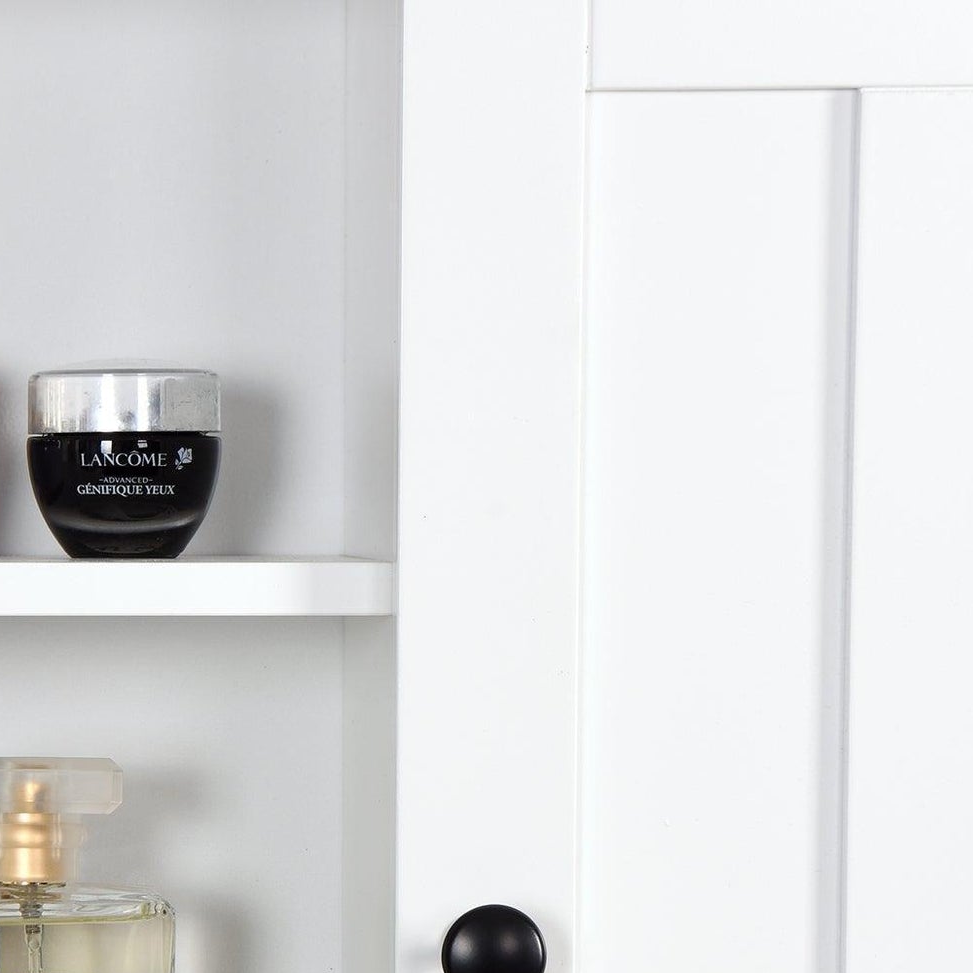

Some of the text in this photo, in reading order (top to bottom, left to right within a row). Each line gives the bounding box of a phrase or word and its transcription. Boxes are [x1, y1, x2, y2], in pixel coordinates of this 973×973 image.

[80, 450, 168, 467] LANCÔME
[76, 482, 176, 498] GÉNIFIQUE YEUX
